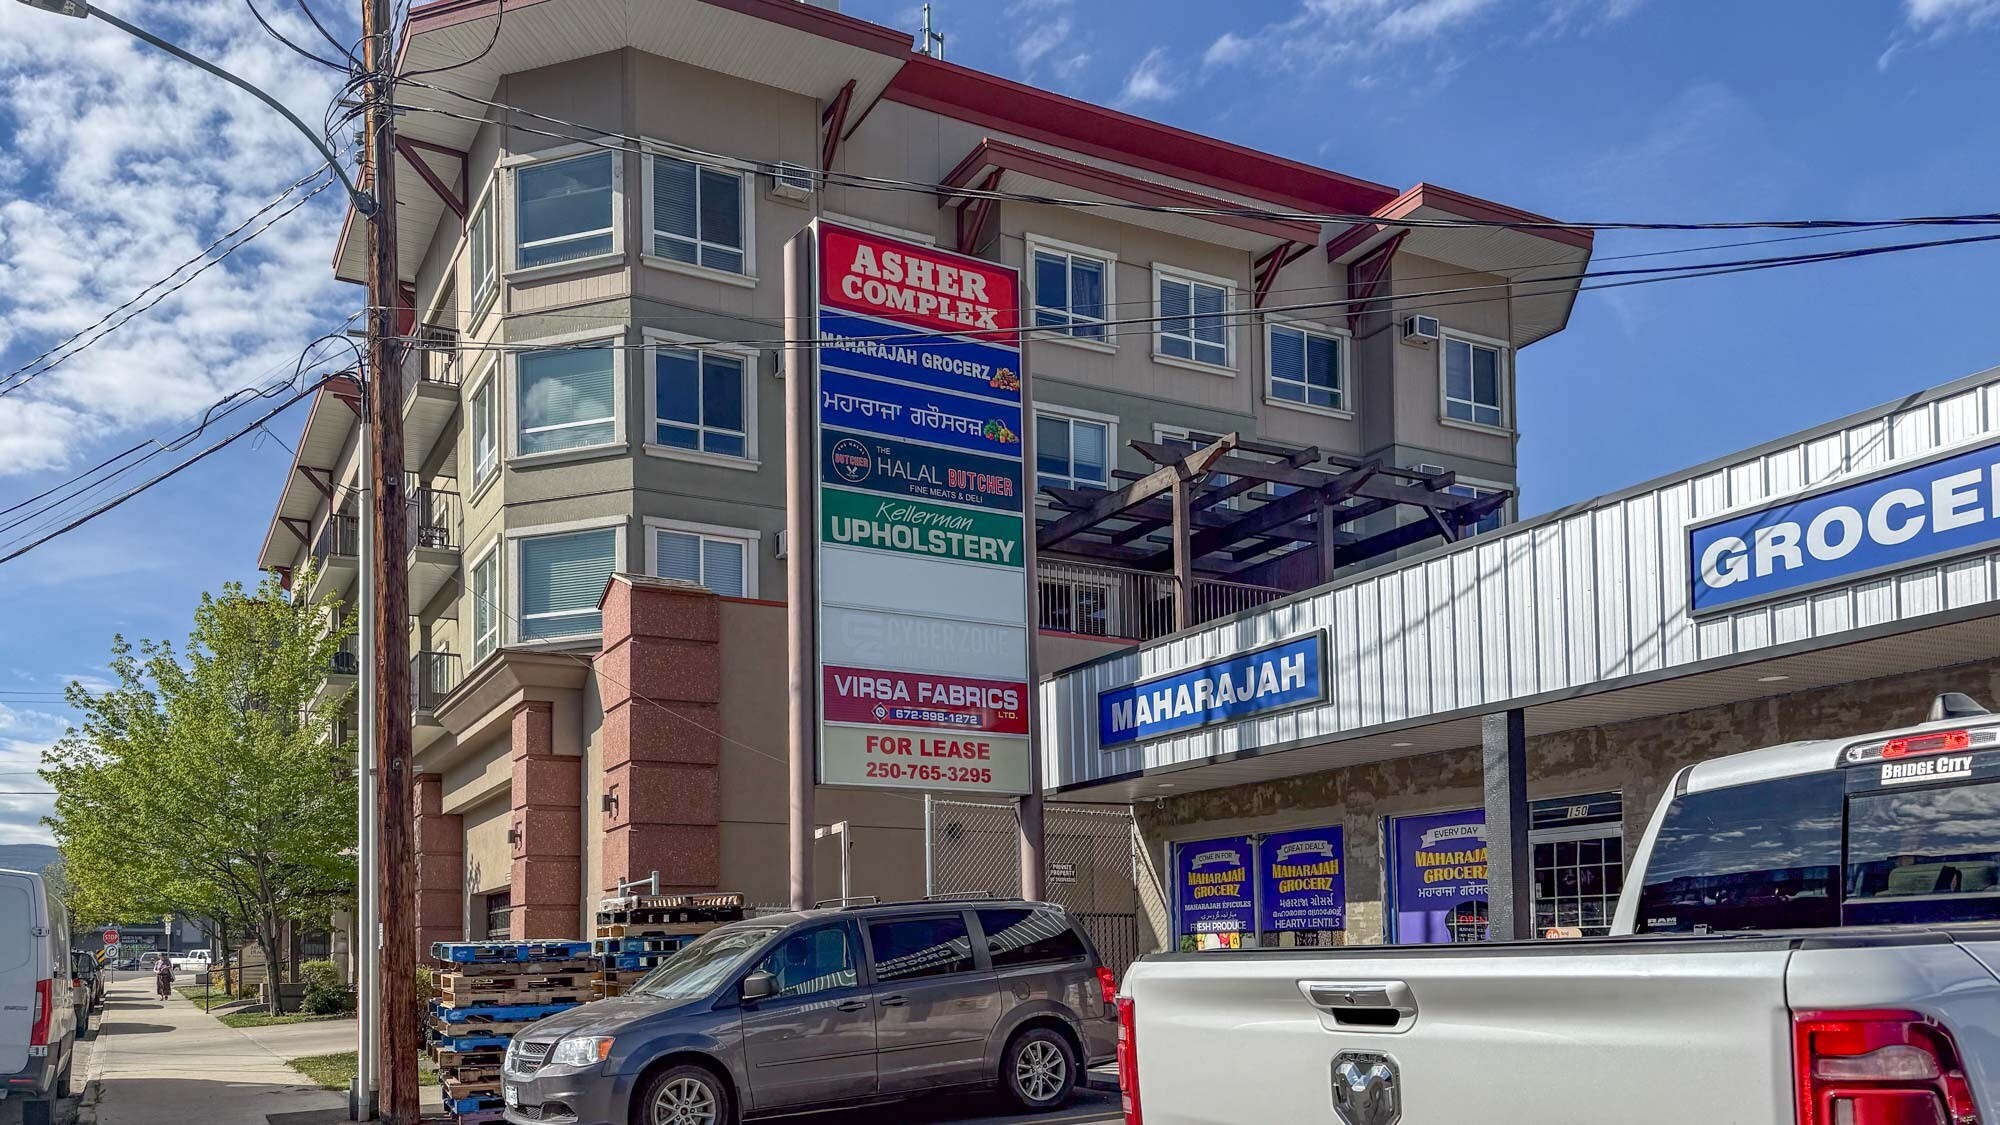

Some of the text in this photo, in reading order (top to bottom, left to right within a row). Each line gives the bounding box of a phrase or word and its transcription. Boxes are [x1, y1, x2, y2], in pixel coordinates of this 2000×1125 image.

[851, 244, 989, 303] ASHER
[842, 274, 998, 330] COMPLEX
[820, 331, 990, 380] MAHARAJAH GROCERZ
[822, 391, 902, 421] ਮਹਾਰਾਜਾ
[876, 446, 890, 454] THE
[834, 453, 868, 468] BUTCHER
[878, 458, 1013, 496] HALAL BUTCHER
[910, 484, 982, 503] FINE MEATS & DELI
[876, 502, 973, 531] Kellerman
[1700, 463, 2000, 588] GROCE
[832, 516, 1014, 562] UPHOLSTERY
[834, 674, 1018, 711] VIRSA FABRICS
[1112, 652, 1306, 732] MAHARAJAH
[896, 709, 978, 724] 672-998-1272
[998, 712, 1018, 720] LTD.
[866, 736, 990, 760] FOR LEASE
[866, 762, 992, 784] 250-765-3295
[1882, 760, 1934, 779] BRIDGE
[1936, 756, 1972, 772] CITY
[1569, 805, 1587, 818] 150
[1434, 826, 1478, 838] EVERY DAY
[1198, 854, 1214, 862] COME
[1284, 842, 1325, 854] GREAT DEALS
[1416, 847, 1488, 868] MAHARAJA
[1188, 866, 1246, 886] MAHARAJAH
[1272, 858, 1338, 878] MAHARAJAH
[1194, 884, 1240, 899] GROCERZ
[1279, 878, 1332, 894] GROCERZ
[1184, 902, 1221, 911] MAHARAJAH
[1190, 920, 1246, 932] FRESH PRODUCE
[1275, 918, 1340, 928] HEARTY LENTILS
